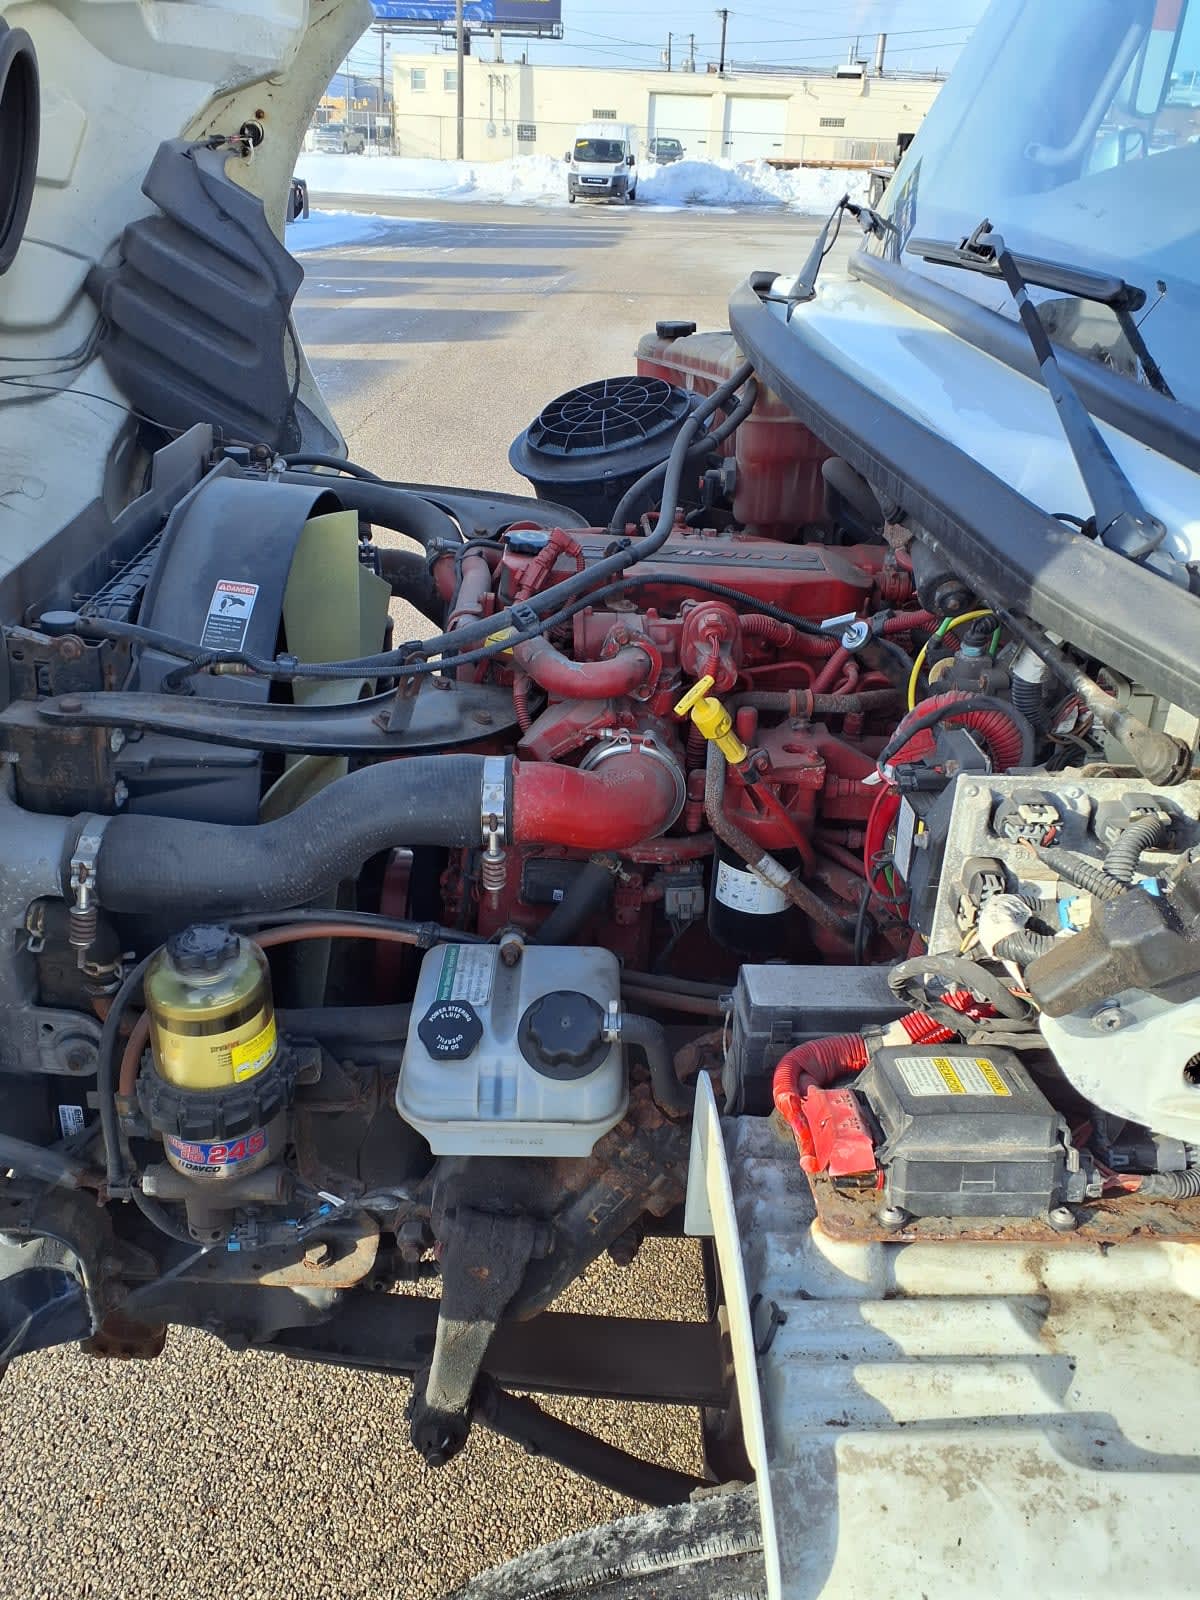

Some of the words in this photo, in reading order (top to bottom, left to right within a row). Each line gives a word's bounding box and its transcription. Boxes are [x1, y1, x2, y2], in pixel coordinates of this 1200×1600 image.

[227, 585, 255, 595] DANGER
[429, 1006, 448, 1022] POWER
[449, 1006, 472, 1022] STEERING
[436, 1034, 463, 1045] OVERFILL
[437, 1043, 449, 1051] NOT
[981, 1063, 1005, 1091] CAUTION
[207, 1131, 265, 1164] 245
[186, 1163, 222, 1173] DAVCO
